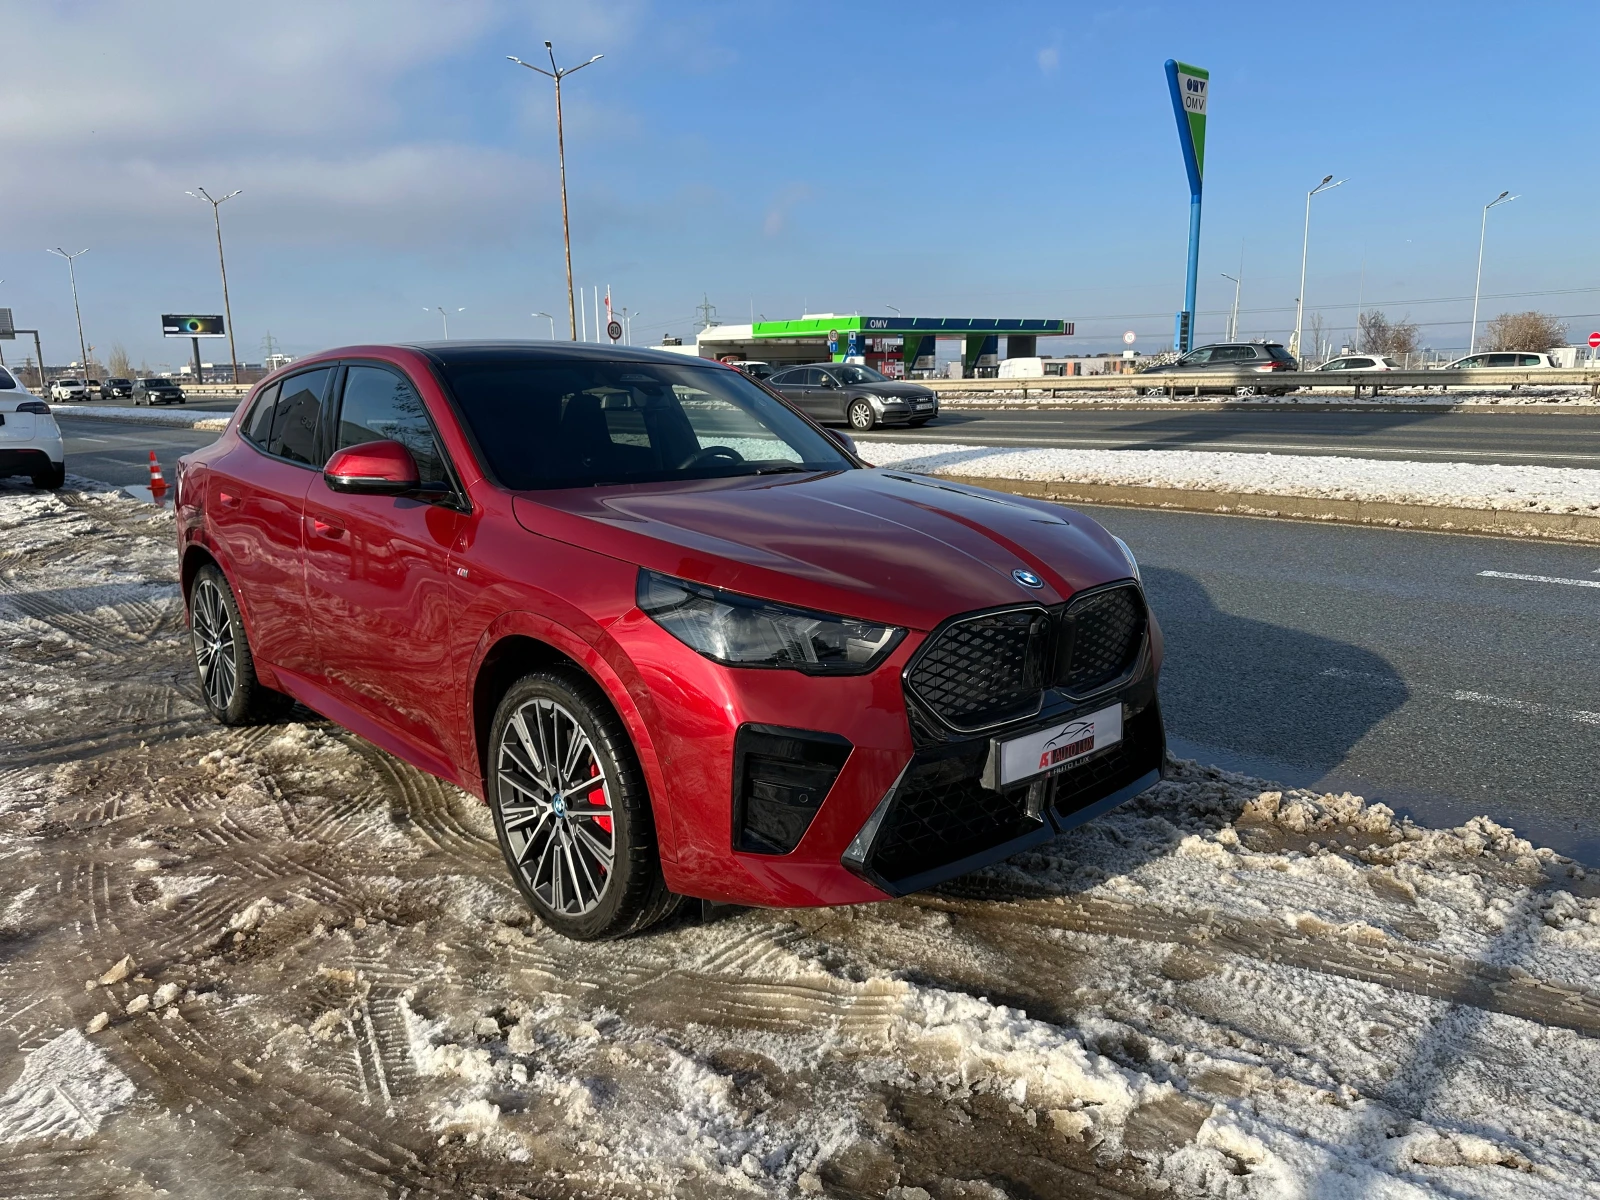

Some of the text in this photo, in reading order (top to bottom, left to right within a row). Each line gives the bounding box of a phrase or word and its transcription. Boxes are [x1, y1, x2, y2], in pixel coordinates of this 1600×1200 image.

[1186, 97, 1205, 110] OMV
[870, 320, 888, 328] OMV
[611, 326, 619, 335] 80
[1039, 737, 1093, 769] A1 AUTO LUX
[1075, 756, 1091, 766] LUX
